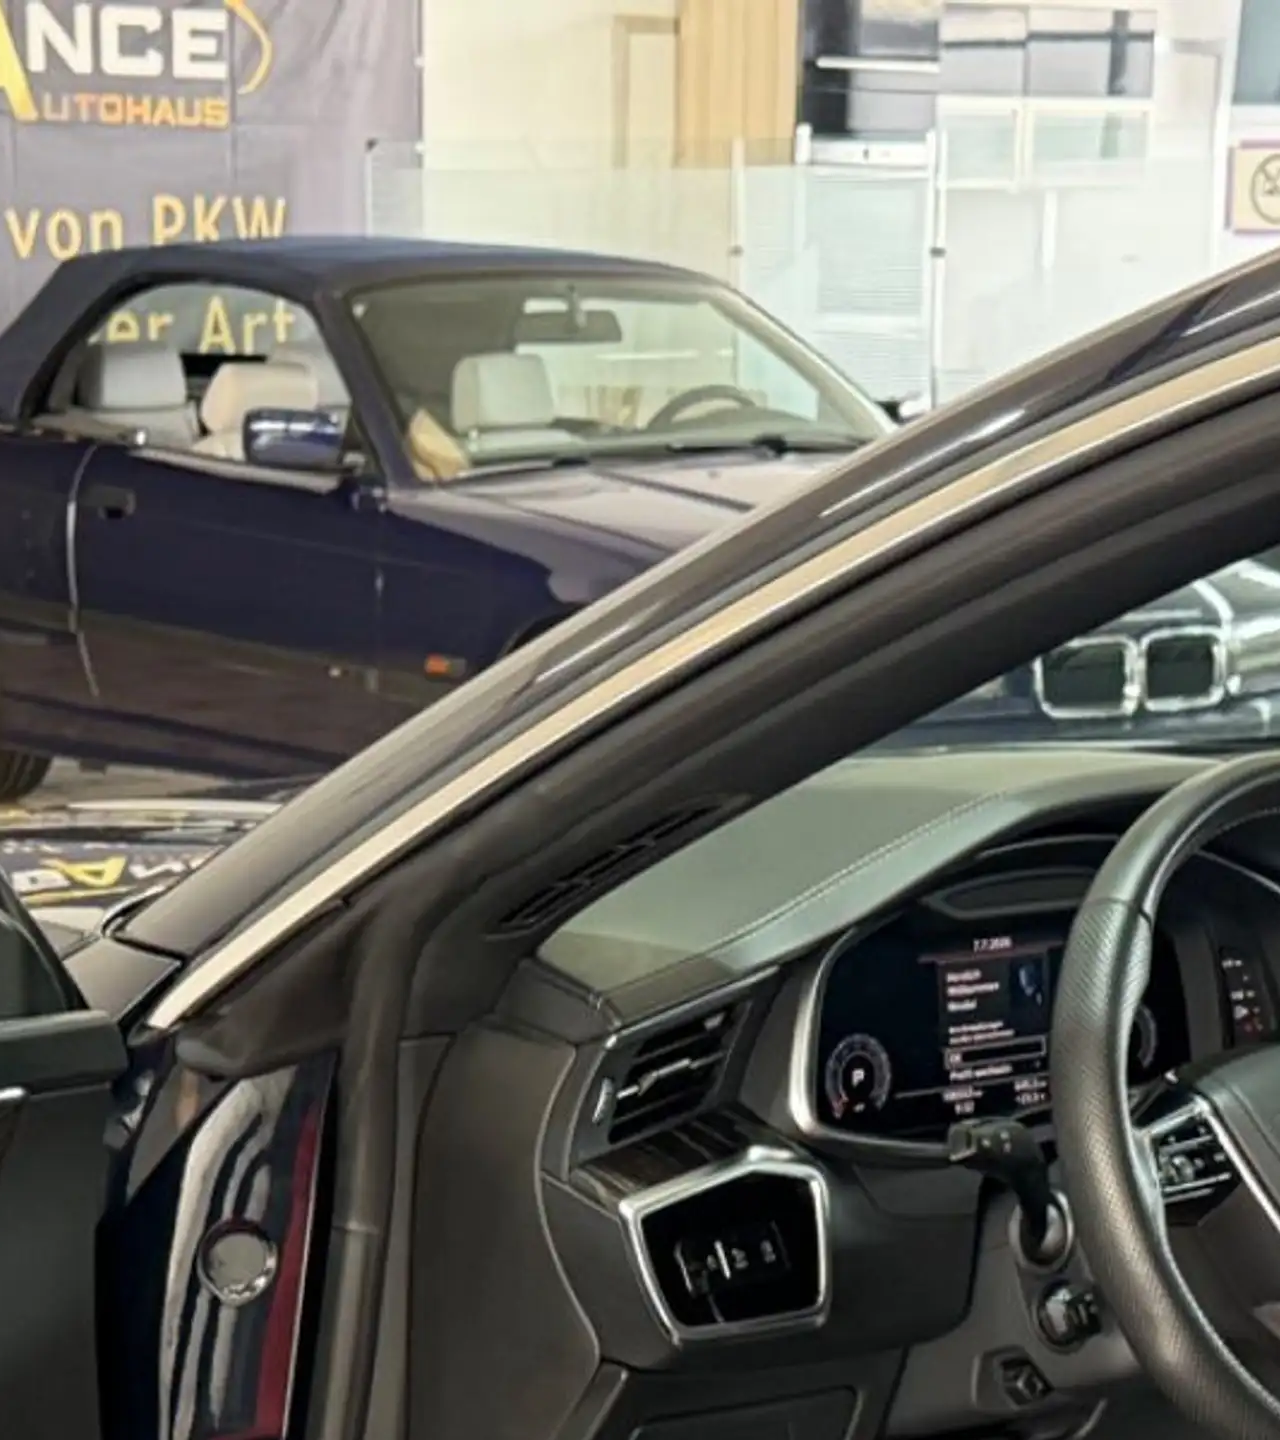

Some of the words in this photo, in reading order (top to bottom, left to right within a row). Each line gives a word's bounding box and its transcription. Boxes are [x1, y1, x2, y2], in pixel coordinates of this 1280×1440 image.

[5, 208, 123, 260] von
[152, 195, 286, 246] PKW
[199, 295, 296, 354] Art
